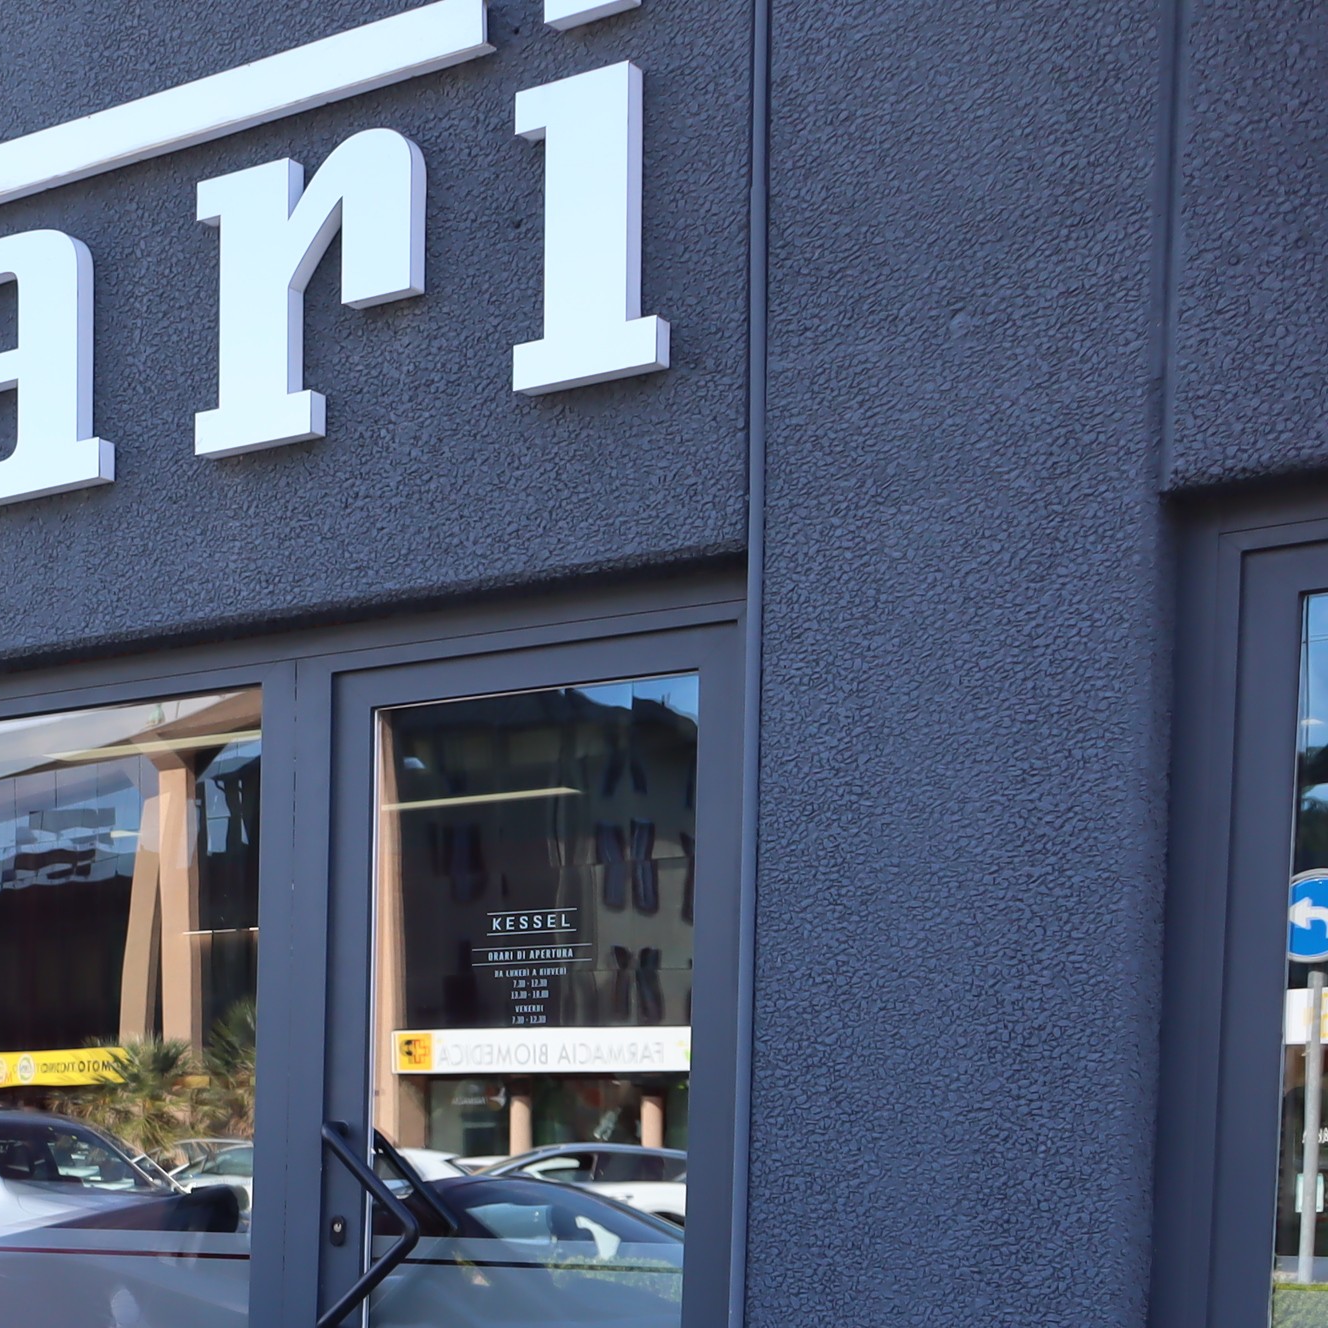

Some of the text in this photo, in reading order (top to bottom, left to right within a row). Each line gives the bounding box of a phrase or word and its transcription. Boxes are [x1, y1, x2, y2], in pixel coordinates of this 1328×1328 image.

[492, 913, 571, 931] KESSEL
[488, 948, 574, 961] ORARI DI APERTURA
